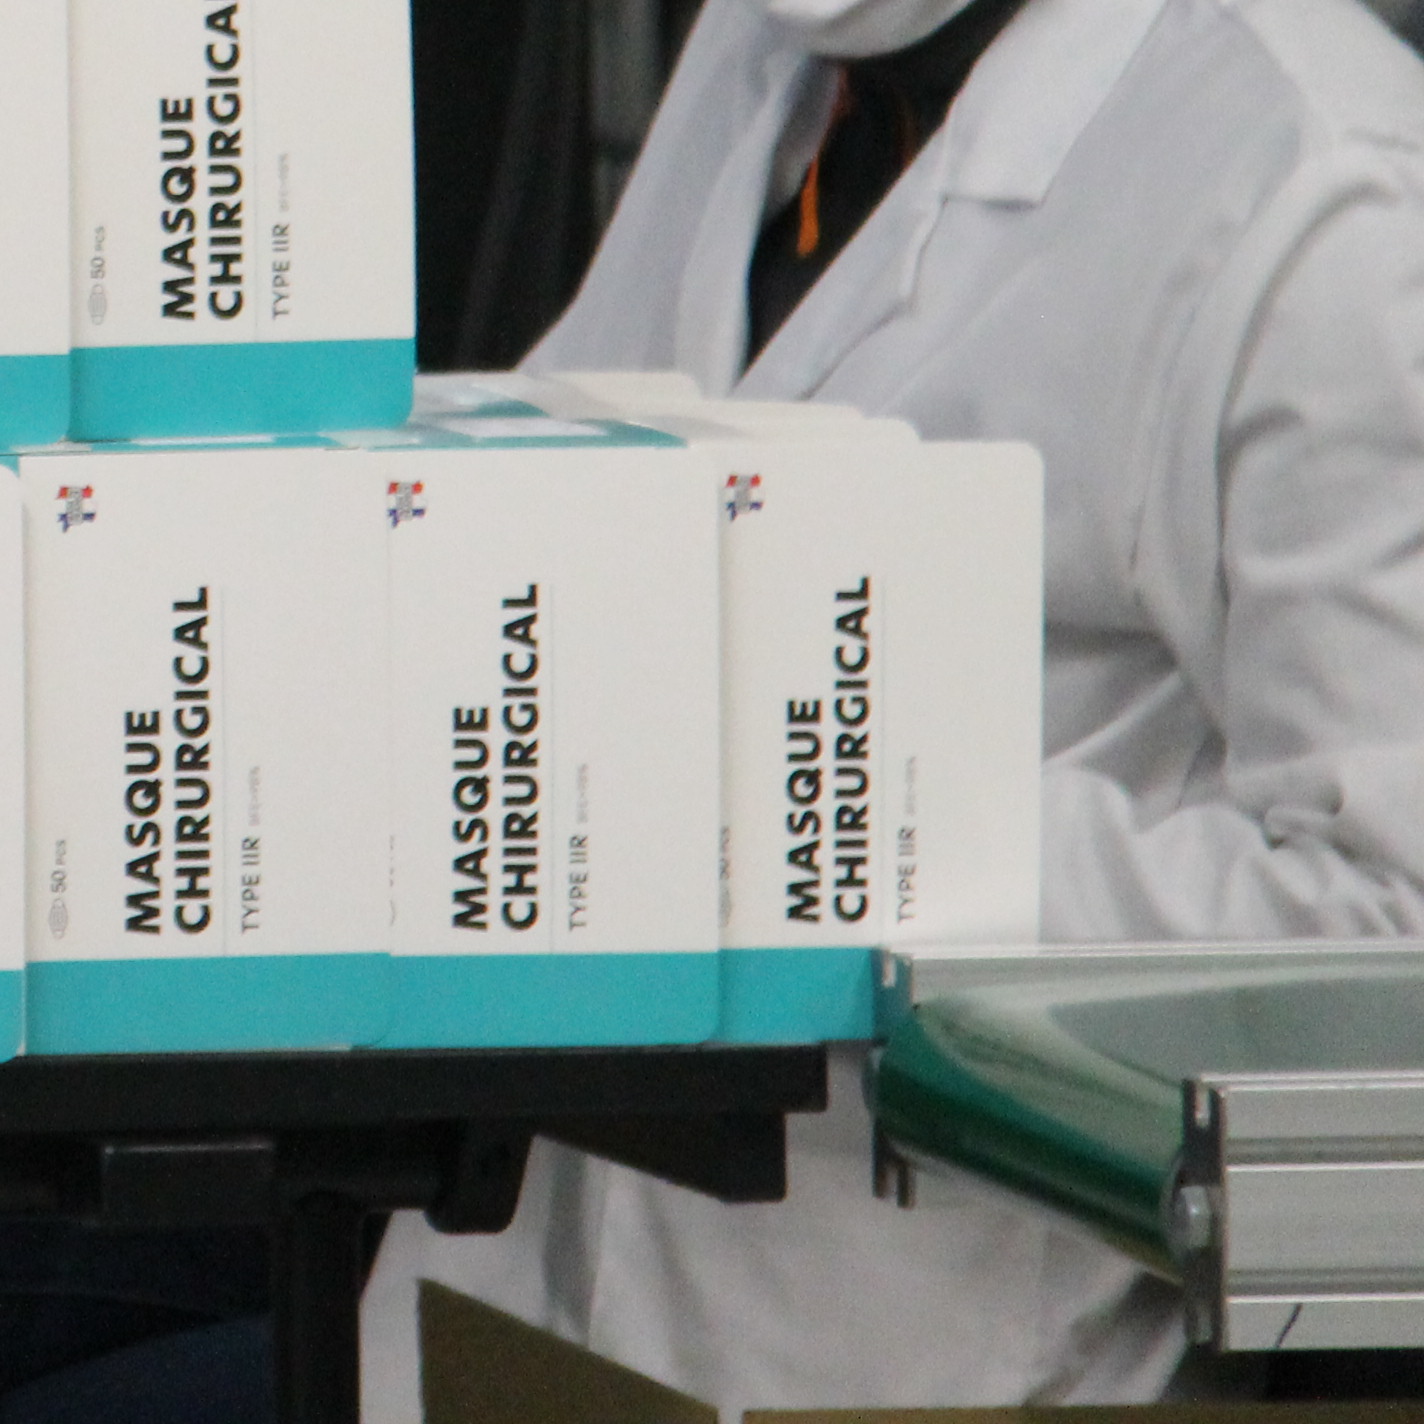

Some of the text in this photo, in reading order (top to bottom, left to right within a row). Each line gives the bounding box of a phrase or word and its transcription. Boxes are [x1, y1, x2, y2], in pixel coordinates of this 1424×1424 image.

[160, 98, 196, 320] MASQUE
[270, 222, 290, 254] IIR
[89, 224, 107, 280] 50 PCS
[270, 260, 292, 320] TYPE
[173, 586, 211, 934] CHIRURGICAL
[501, 584, 539, 931] CHIRURGICAL
[833, 577, 870, 923] CHIRURGICAL
[125, 710, 162, 934] MASQUE
[452, 707, 490, 931] MASQUE
[786, 699, 822, 923] MASQUE
[896, 825, 917, 857] IIR
[49, 837, 68, 894] 50 PCS
[240, 836, 261, 867] IIR
[568, 833, 589, 865] IIR
[239, 874, 262, 934] TYPE
[567, 871, 590, 932] TYPE
[895, 862, 918, 924] TYPE
